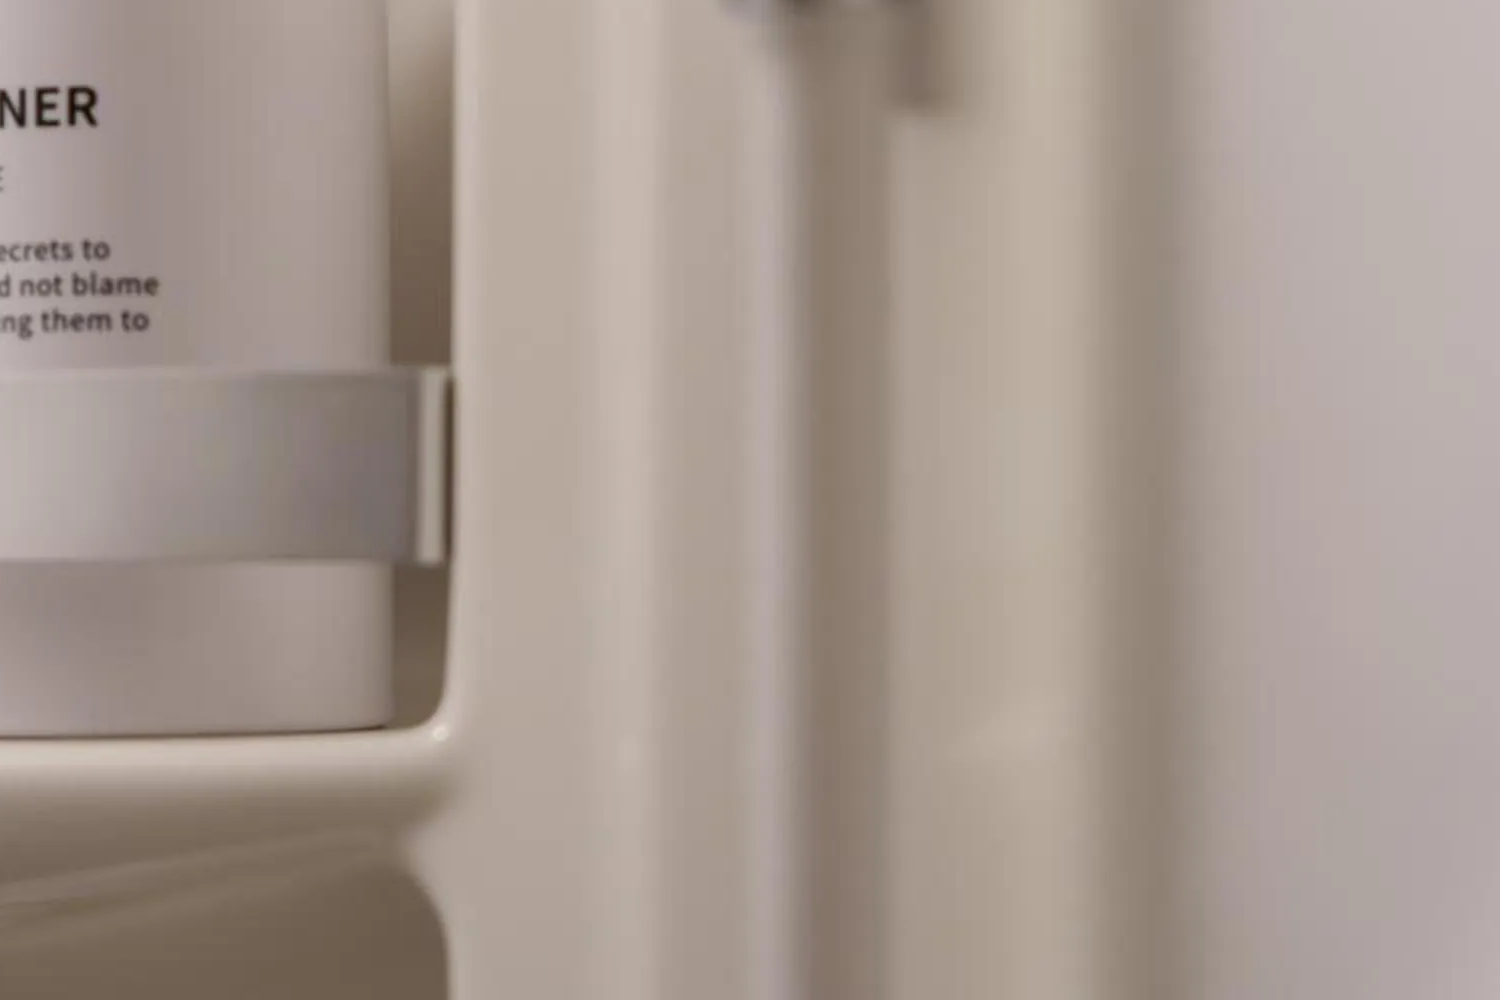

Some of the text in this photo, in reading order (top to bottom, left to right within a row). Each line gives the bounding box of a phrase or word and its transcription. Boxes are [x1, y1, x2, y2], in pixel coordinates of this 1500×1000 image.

[82, 239, 112, 262] to
[20, 276, 64, 297] not
[71, 271, 159, 296] blame
[41, 308, 112, 333] them
[121, 309, 150, 333] to
